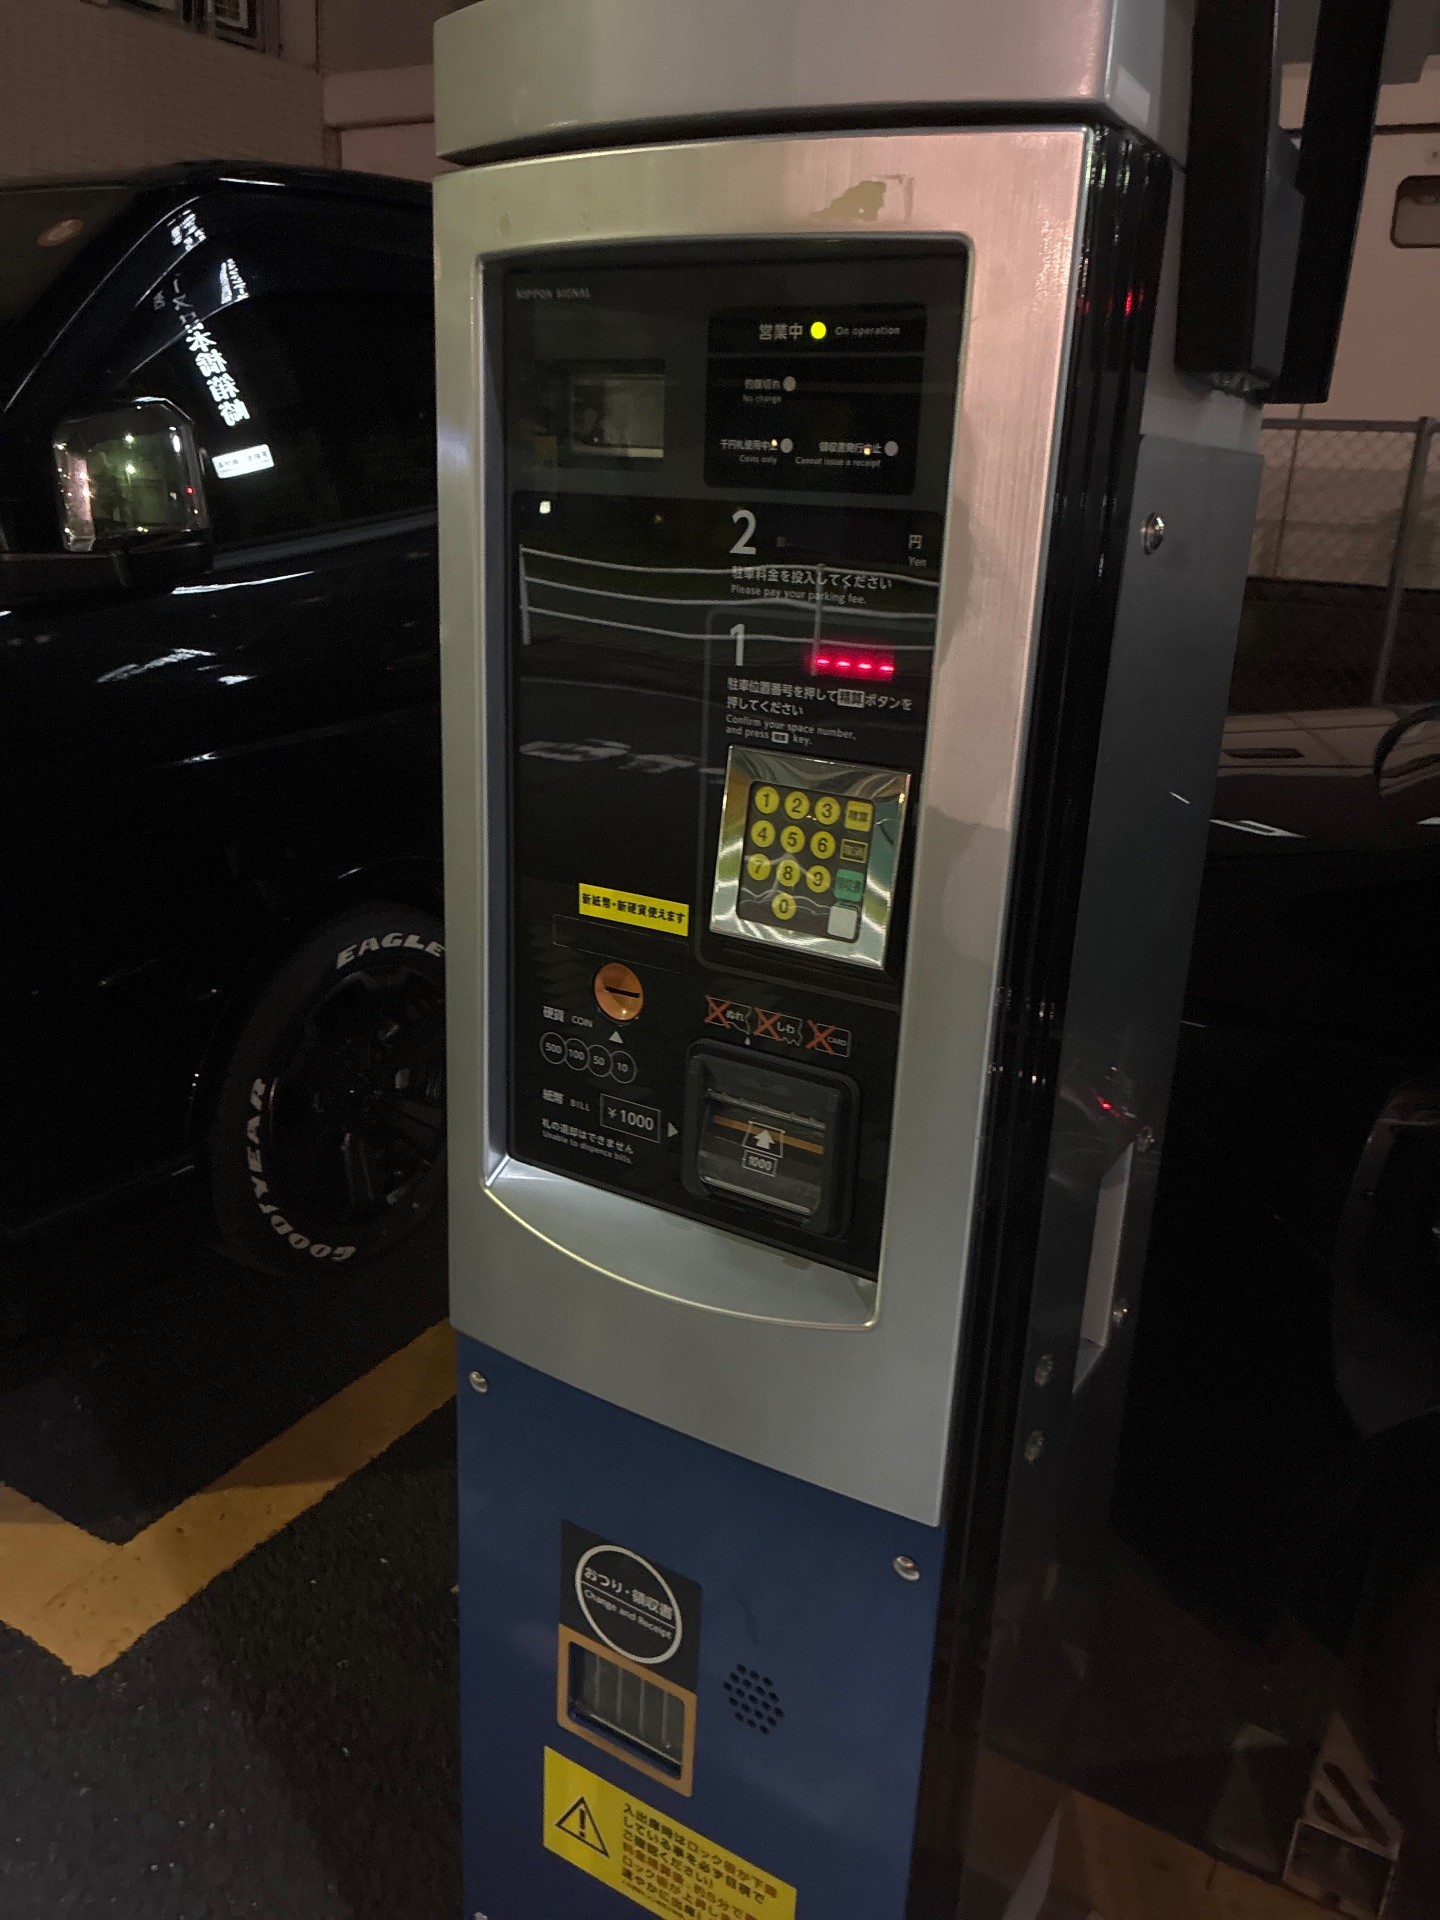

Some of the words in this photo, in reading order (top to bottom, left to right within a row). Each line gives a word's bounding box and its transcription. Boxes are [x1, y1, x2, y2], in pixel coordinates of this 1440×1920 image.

[516, 288, 553, 299] NIPPON
[556, 287, 592, 299] SIGNAL
[759, 323, 803, 340] 営業中
[852, 325, 901, 337] operation
[729, 509, 757, 555] 2
[908, 534, 922, 549] 円
[908, 556, 927, 567] Yen
[731, 565, 893, 590] 駐車料金を投入してください
[730, 584, 761, 596] Please
[763, 587, 781, 598] pay
[784, 590, 805, 600] your
[808, 591, 846, 604] parking
[729, 623, 746, 667] 1
[726, 696, 804, 716] 押してください
[725, 714, 762, 727] Confirm
[764, 719, 785, 730] your
[787, 723, 815, 735] space
[725, 725, 742, 736] and
[745, 728, 769, 739] press
[762, 793, 772, 807] 1
[791, 798, 803, 814] 2
[821, 803, 833, 819] 3
[756, 826, 769, 842] 4
[786, 832, 799, 847] 5
[817, 838, 829, 853] 6
[753, 860, 765, 875] 7
[782, 866, 794, 881] 8
[813, 871, 825, 887] 9
[582, 892, 686, 924] 新紙幣・新硬貨使えます
[777, 898, 789, 914] 0
[336, 932, 446, 970] EAGLE
[542, 1006, 565, 1023] 硬貨
[571, 1015, 593, 1028] COIN
[776, 1021, 796, 1034] しわ
[545, 1043, 563, 1054] 500
[568, 1049, 585, 1061] 100
[593, 1055, 605, 1066] 50
[617, 1062, 629, 1073] 10
[570, 1098, 590, 1112] BILL
[247, 1077, 356, 1262] GOODYEAR
[748, 1156, 773, 1171] 1000
[584, 1589, 618, 1611] Change
[619, 1608, 637, 1621] and
